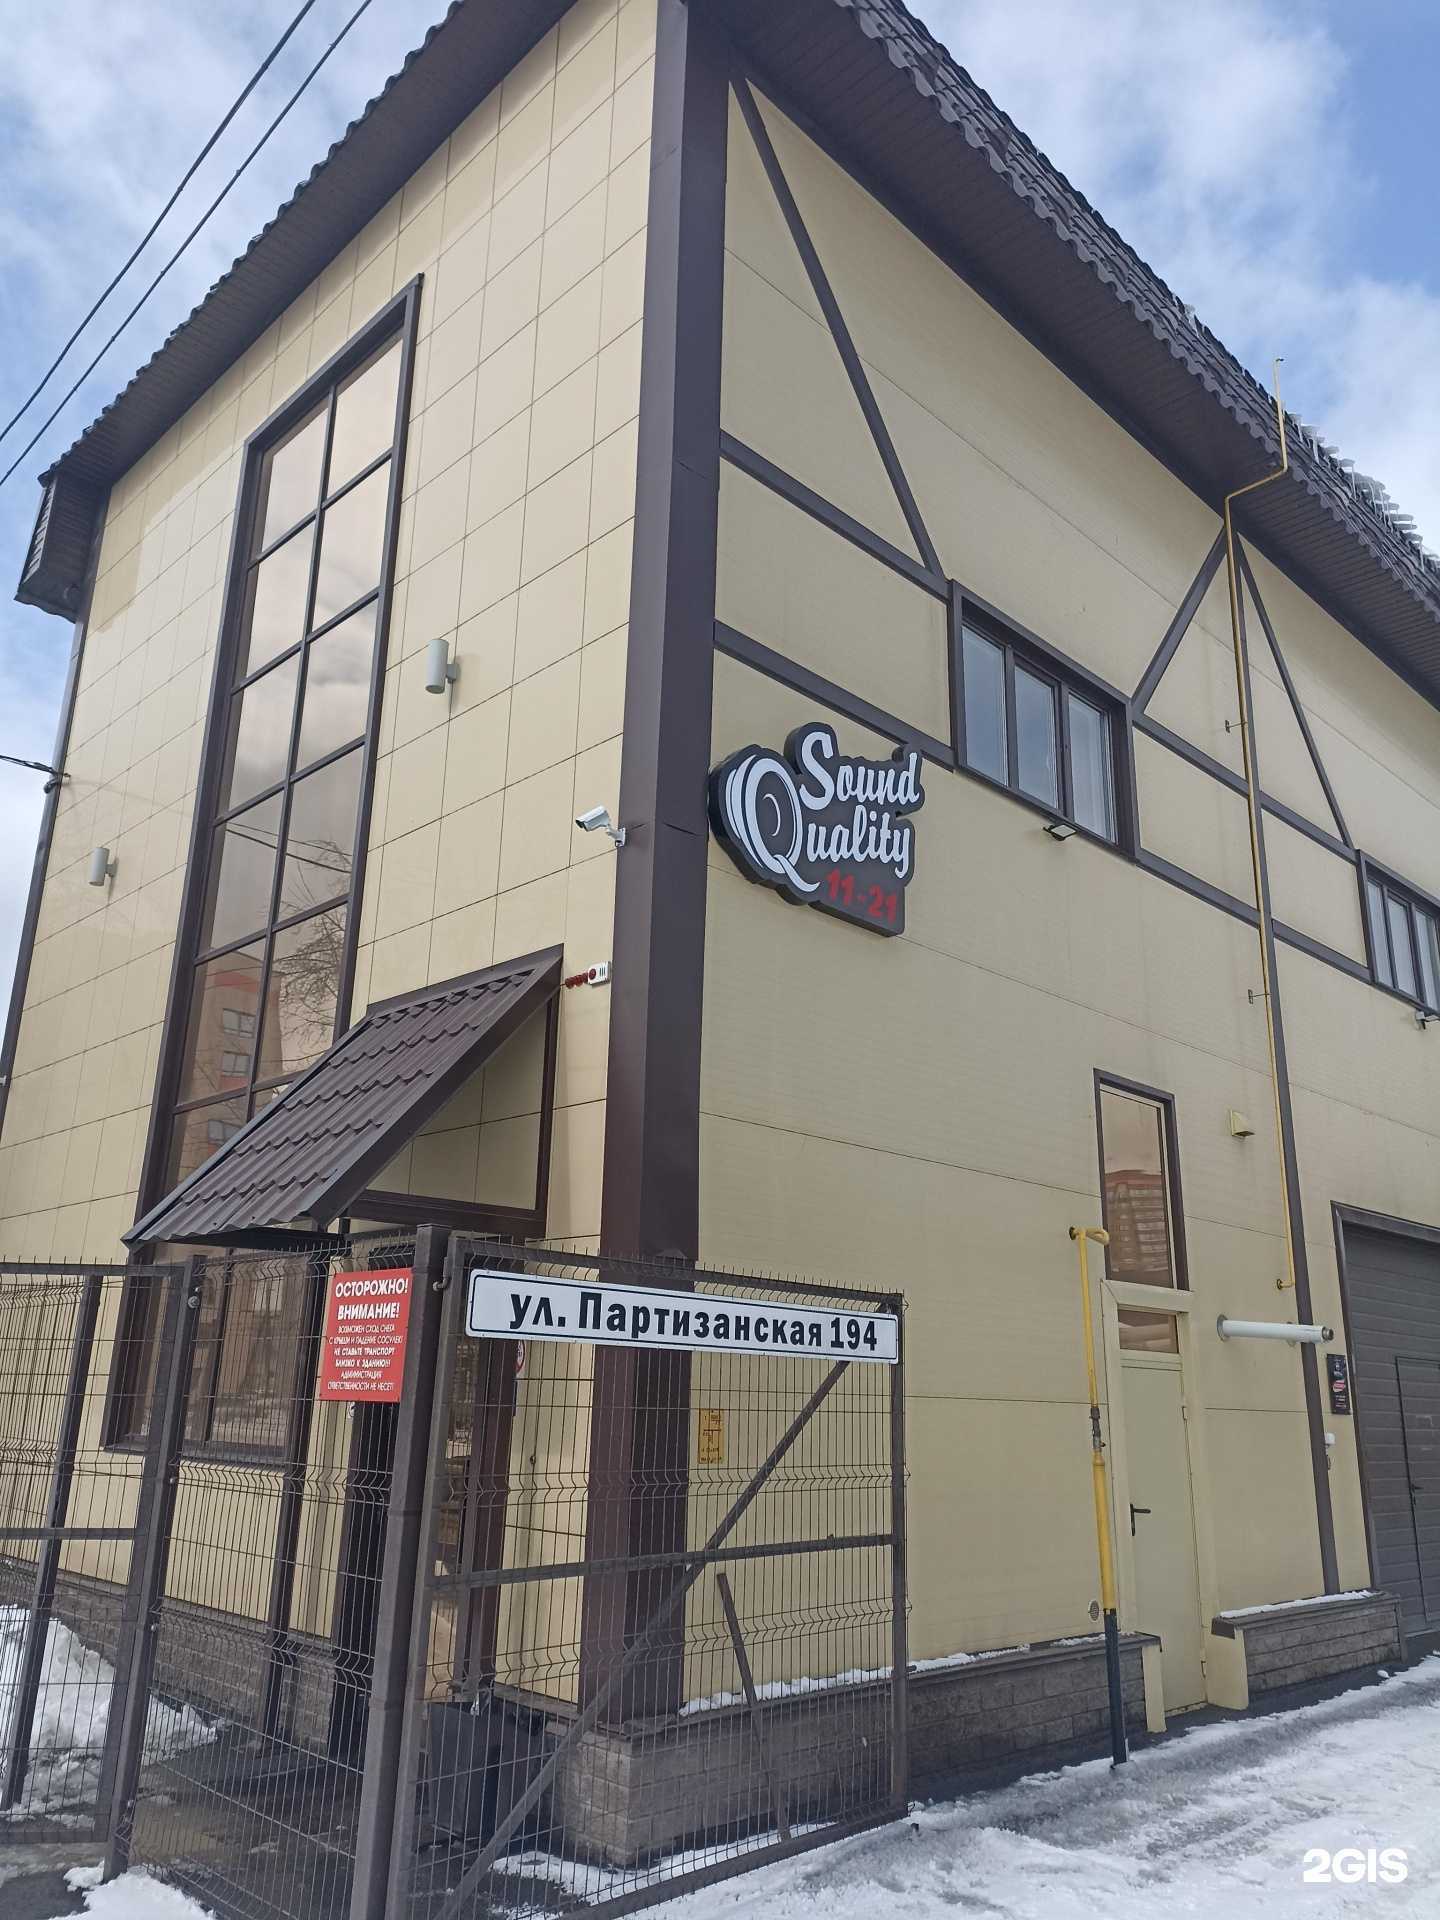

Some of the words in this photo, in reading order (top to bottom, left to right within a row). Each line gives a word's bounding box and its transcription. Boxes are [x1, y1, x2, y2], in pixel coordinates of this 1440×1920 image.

[799, 731, 920, 810] Sound
[725, 754, 911, 892] Quality
[827, 868, 897, 925] 11-21
[335, 1278, 409, 1298] ОСТОРОЖНО!
[337, 1302, 400, 1321] ВНИМАНИЕ!
[510, 1293, 566, 1329] ул.
[577, 1291, 822, 1348] Партизанская
[829, 1319, 878, 1351] 194
[334, 1347, 341, 1356] НЕ
[341, 1347, 362, 1356] СТАВЬТЕ
[364, 1347, 395, 1356] ТРАНСПОРТ
[335, 1358, 355, 1367] БЛИЗКО
